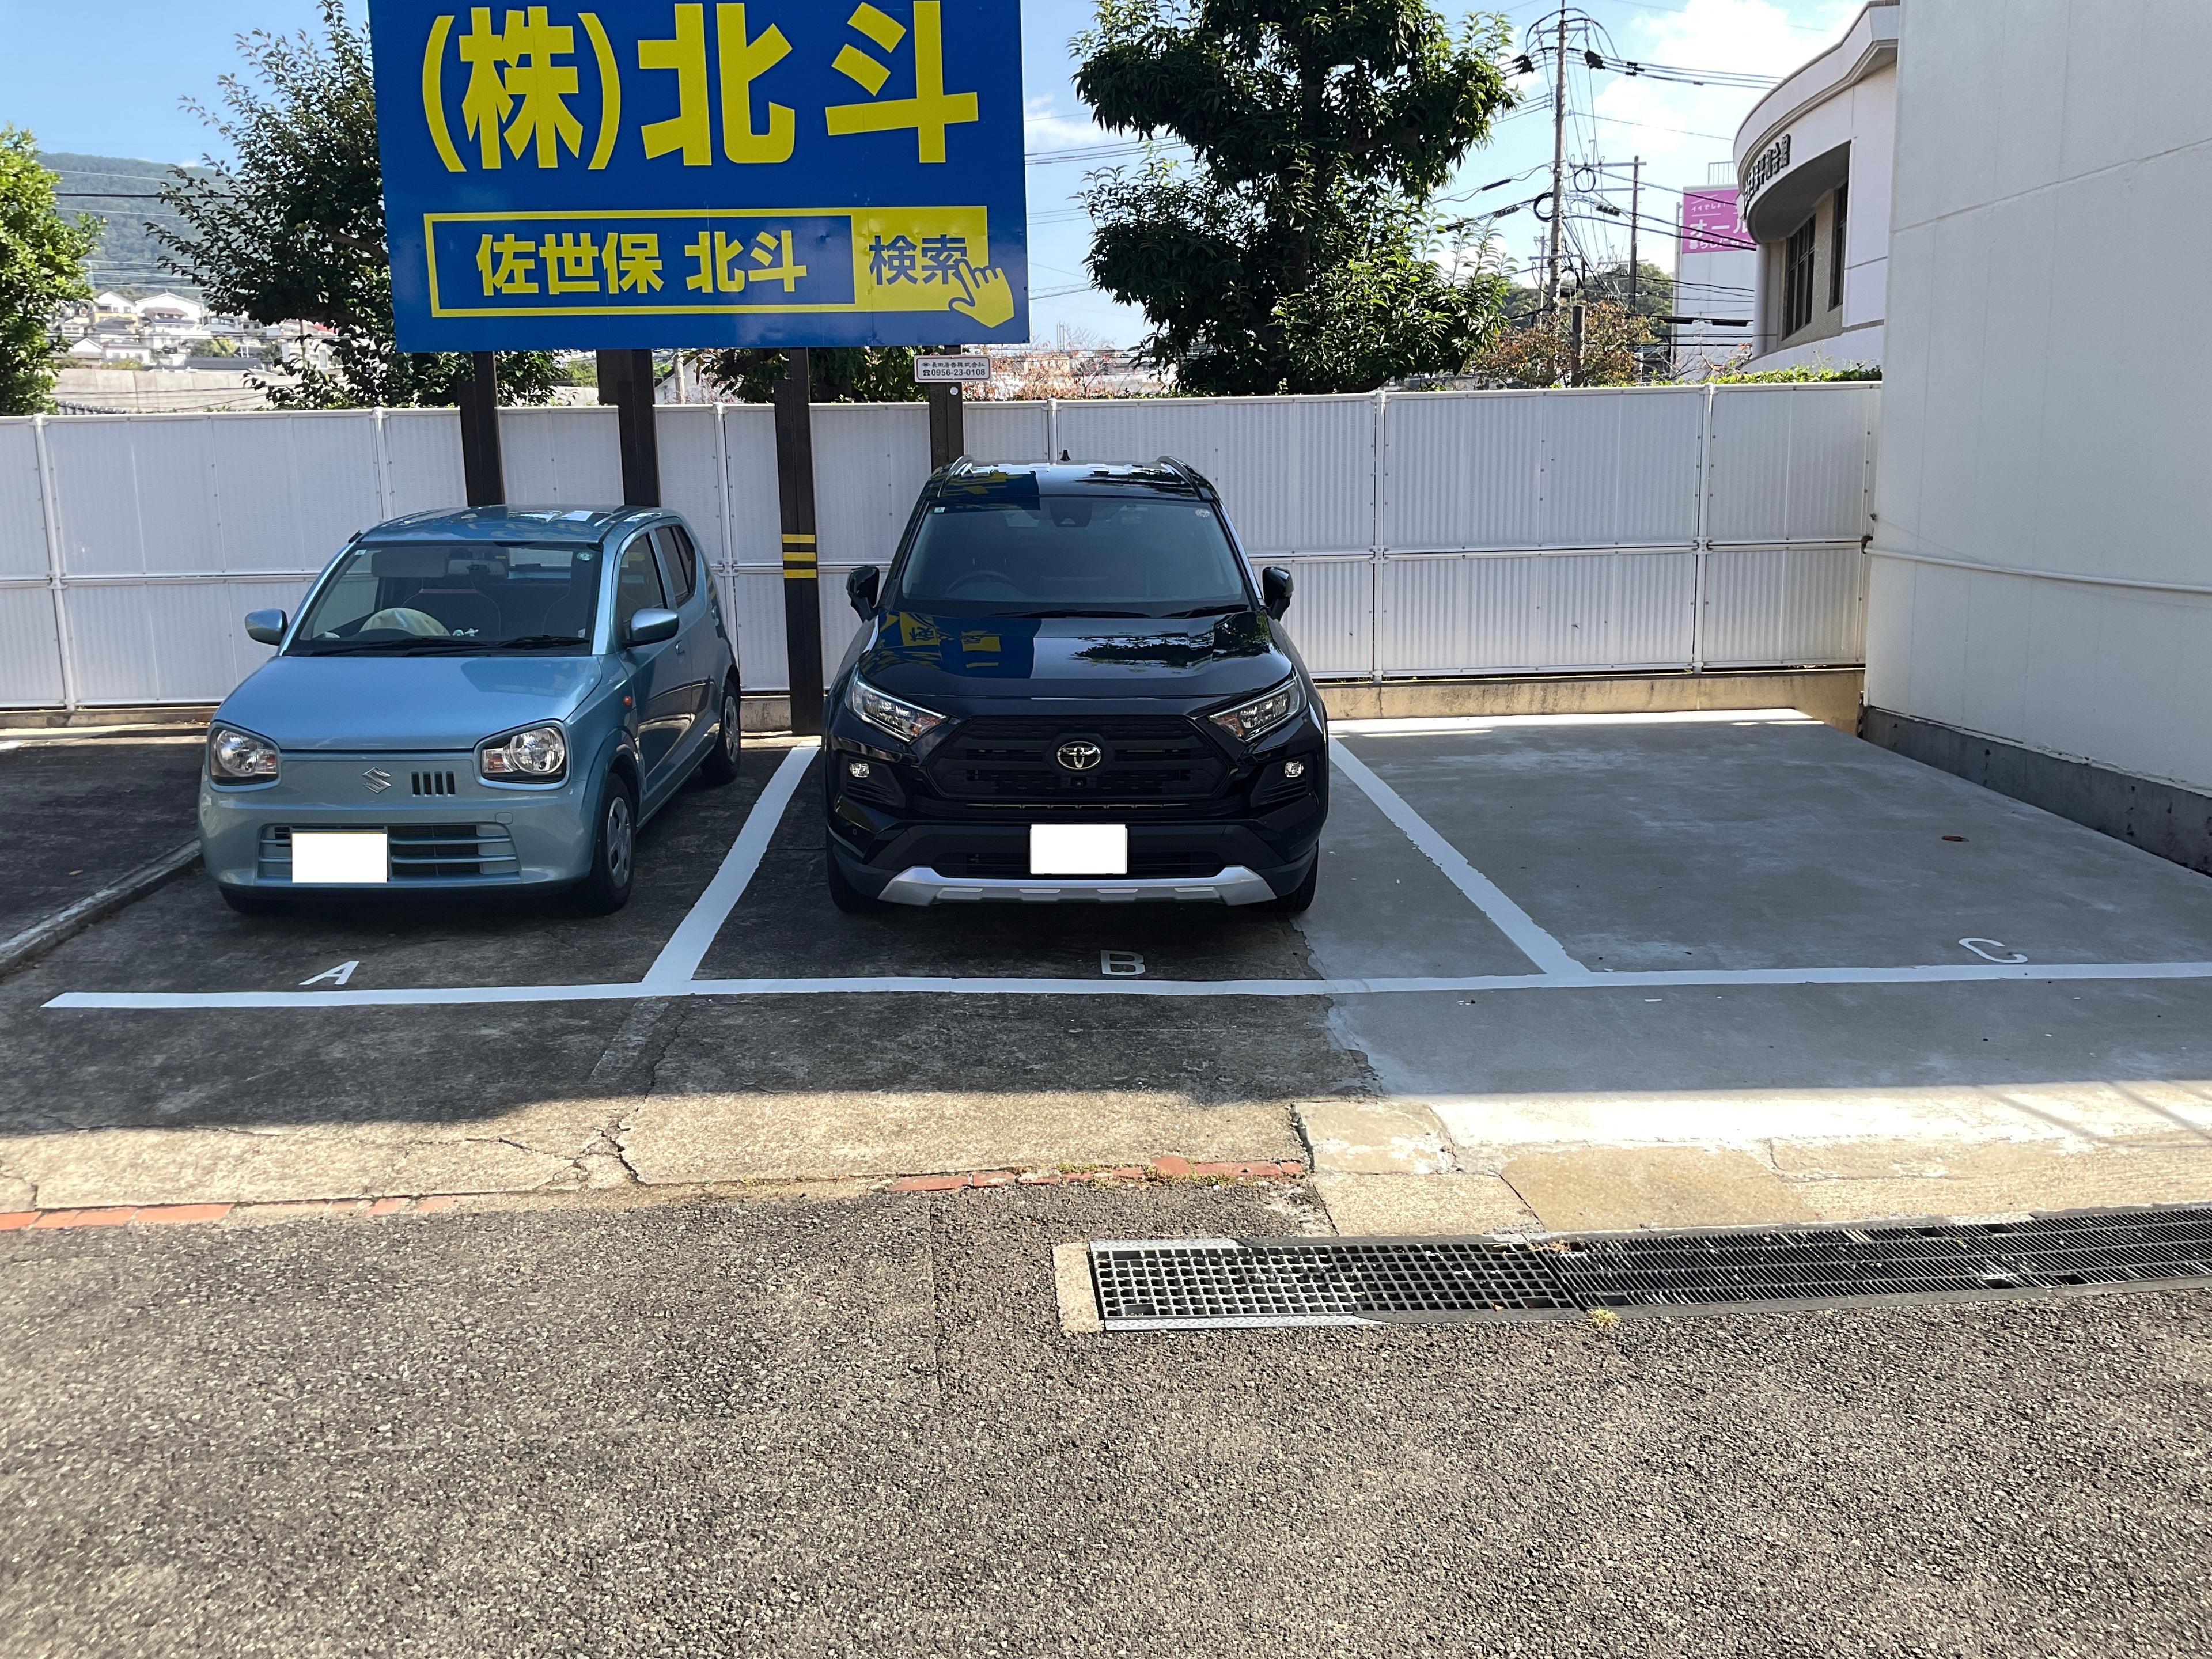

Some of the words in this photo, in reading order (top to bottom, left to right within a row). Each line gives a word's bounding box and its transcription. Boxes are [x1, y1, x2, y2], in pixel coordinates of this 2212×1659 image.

[422, 0, 979, 172] (株)北斗
[476, 232, 665, 297] 佐世保
[685, 229, 808, 294] 北斗
[869, 234, 968, 285] 検索
[1100, 950, 1146, 975] B
[1959, 938, 2028, 963] C
[298, 961, 359, 985] A
